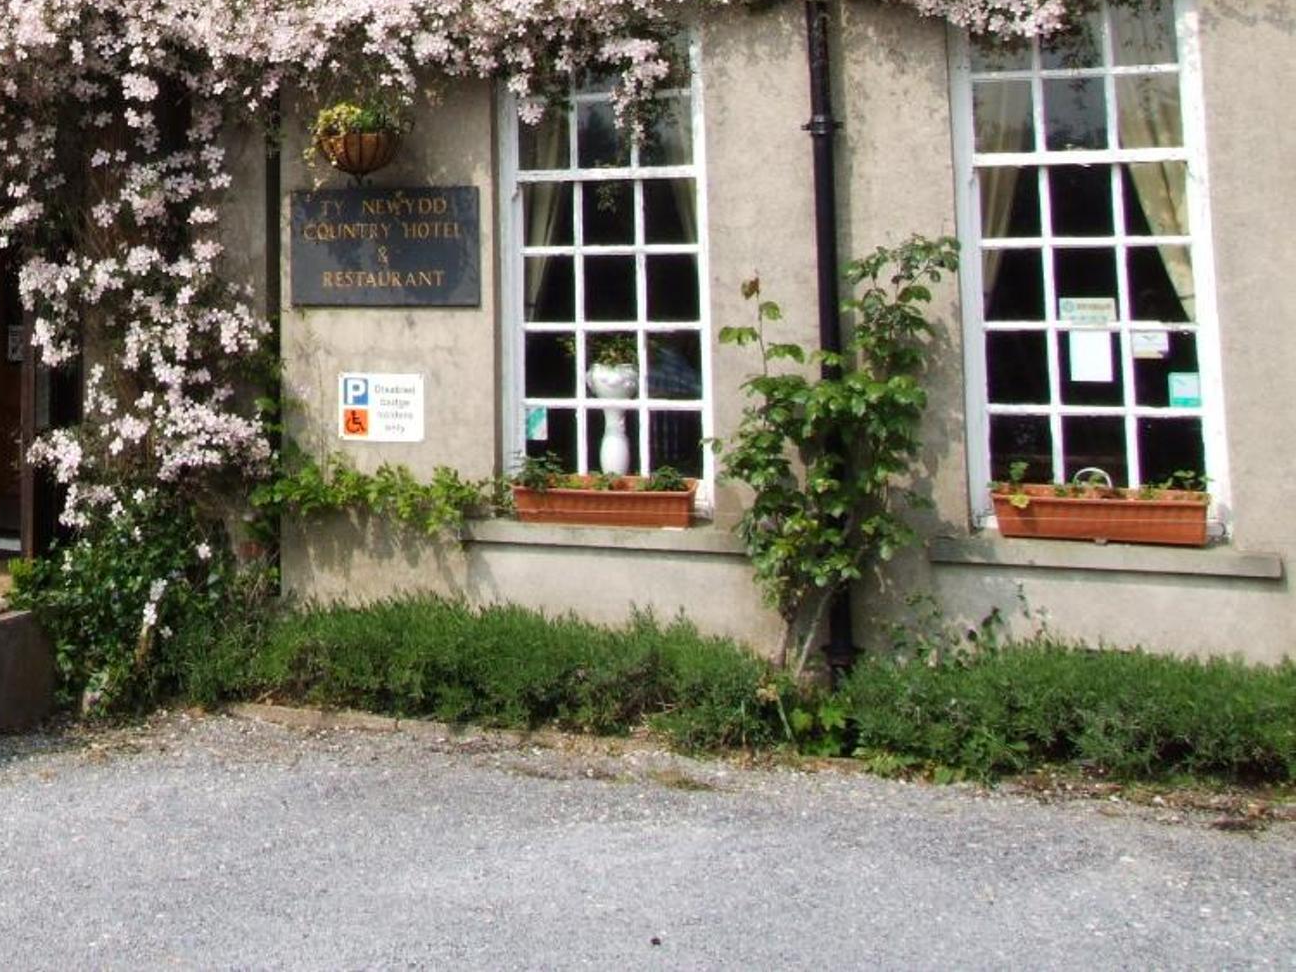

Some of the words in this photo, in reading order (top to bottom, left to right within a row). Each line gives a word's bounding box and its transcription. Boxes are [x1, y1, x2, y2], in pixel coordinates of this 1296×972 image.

[321, 200, 345, 215] TY
[303, 222, 391, 240] COUNTRY
[404, 222, 461, 239] HOTEL
[377, 245, 389, 264] &
[322, 270, 444, 287] RESTAURANT
